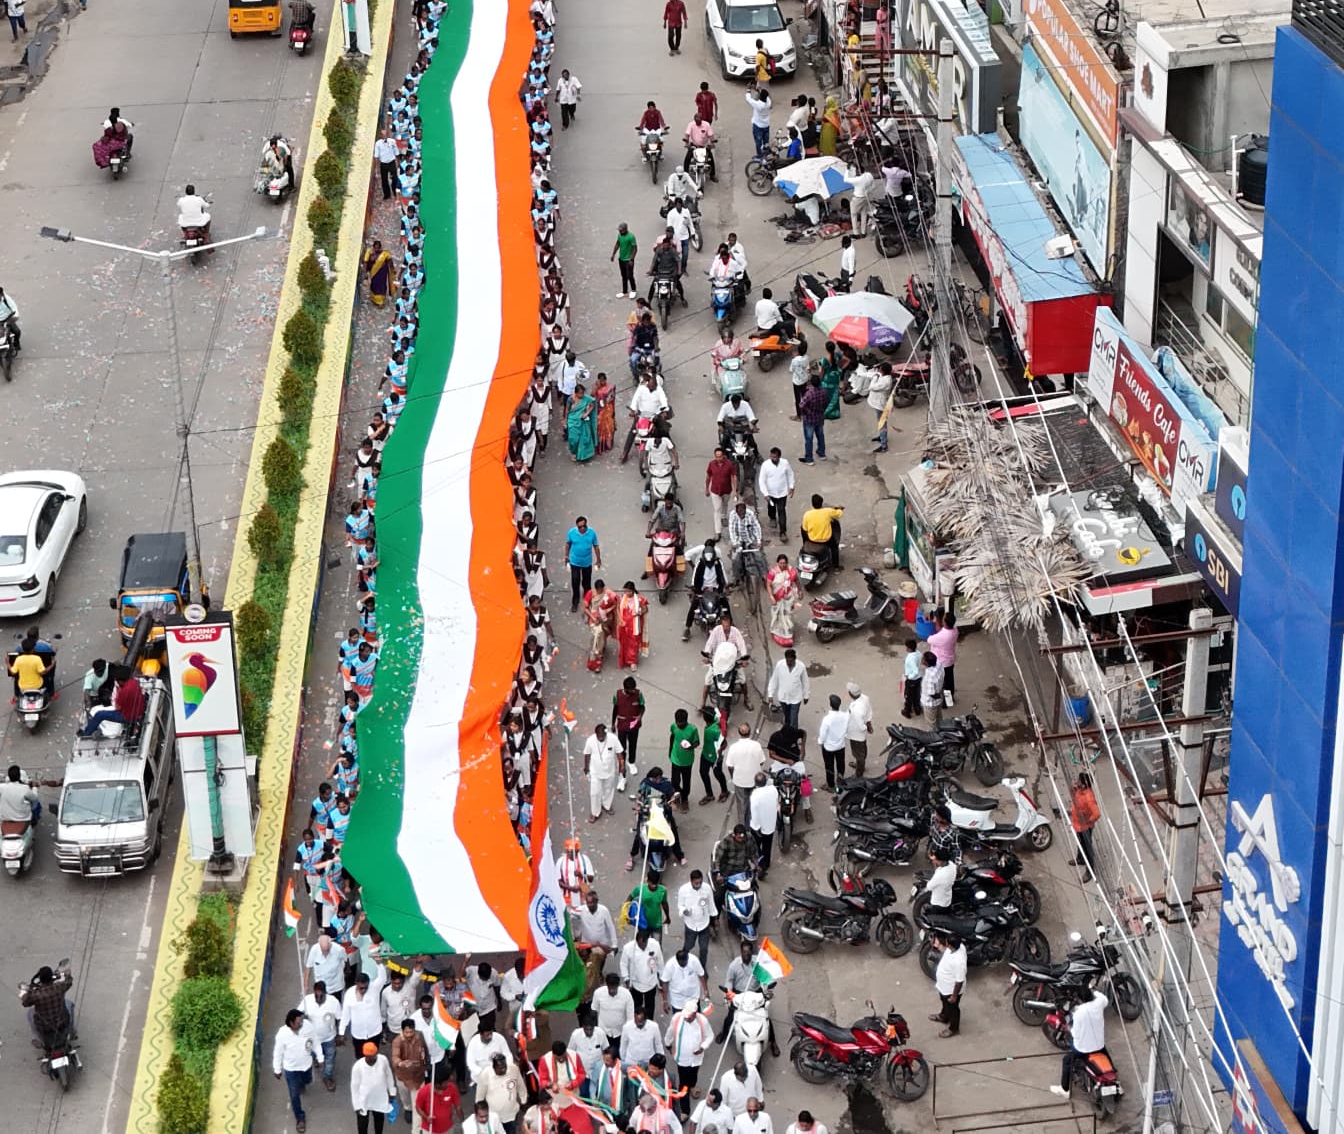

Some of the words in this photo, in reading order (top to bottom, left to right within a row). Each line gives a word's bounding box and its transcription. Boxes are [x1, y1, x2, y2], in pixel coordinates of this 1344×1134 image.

[1069, 46, 1089, 86] SHOE
[1089, 71, 1115, 116] MART
[1094, 325, 1116, 370] CMR
[1119, 352, 1152, 414] Friends
[1153, 401, 1177, 446] Cafe
[1178, 437, 1205, 488] CMR
[1207, 547, 1230, 596] SBI
[179, 627, 217, 636] COMING
